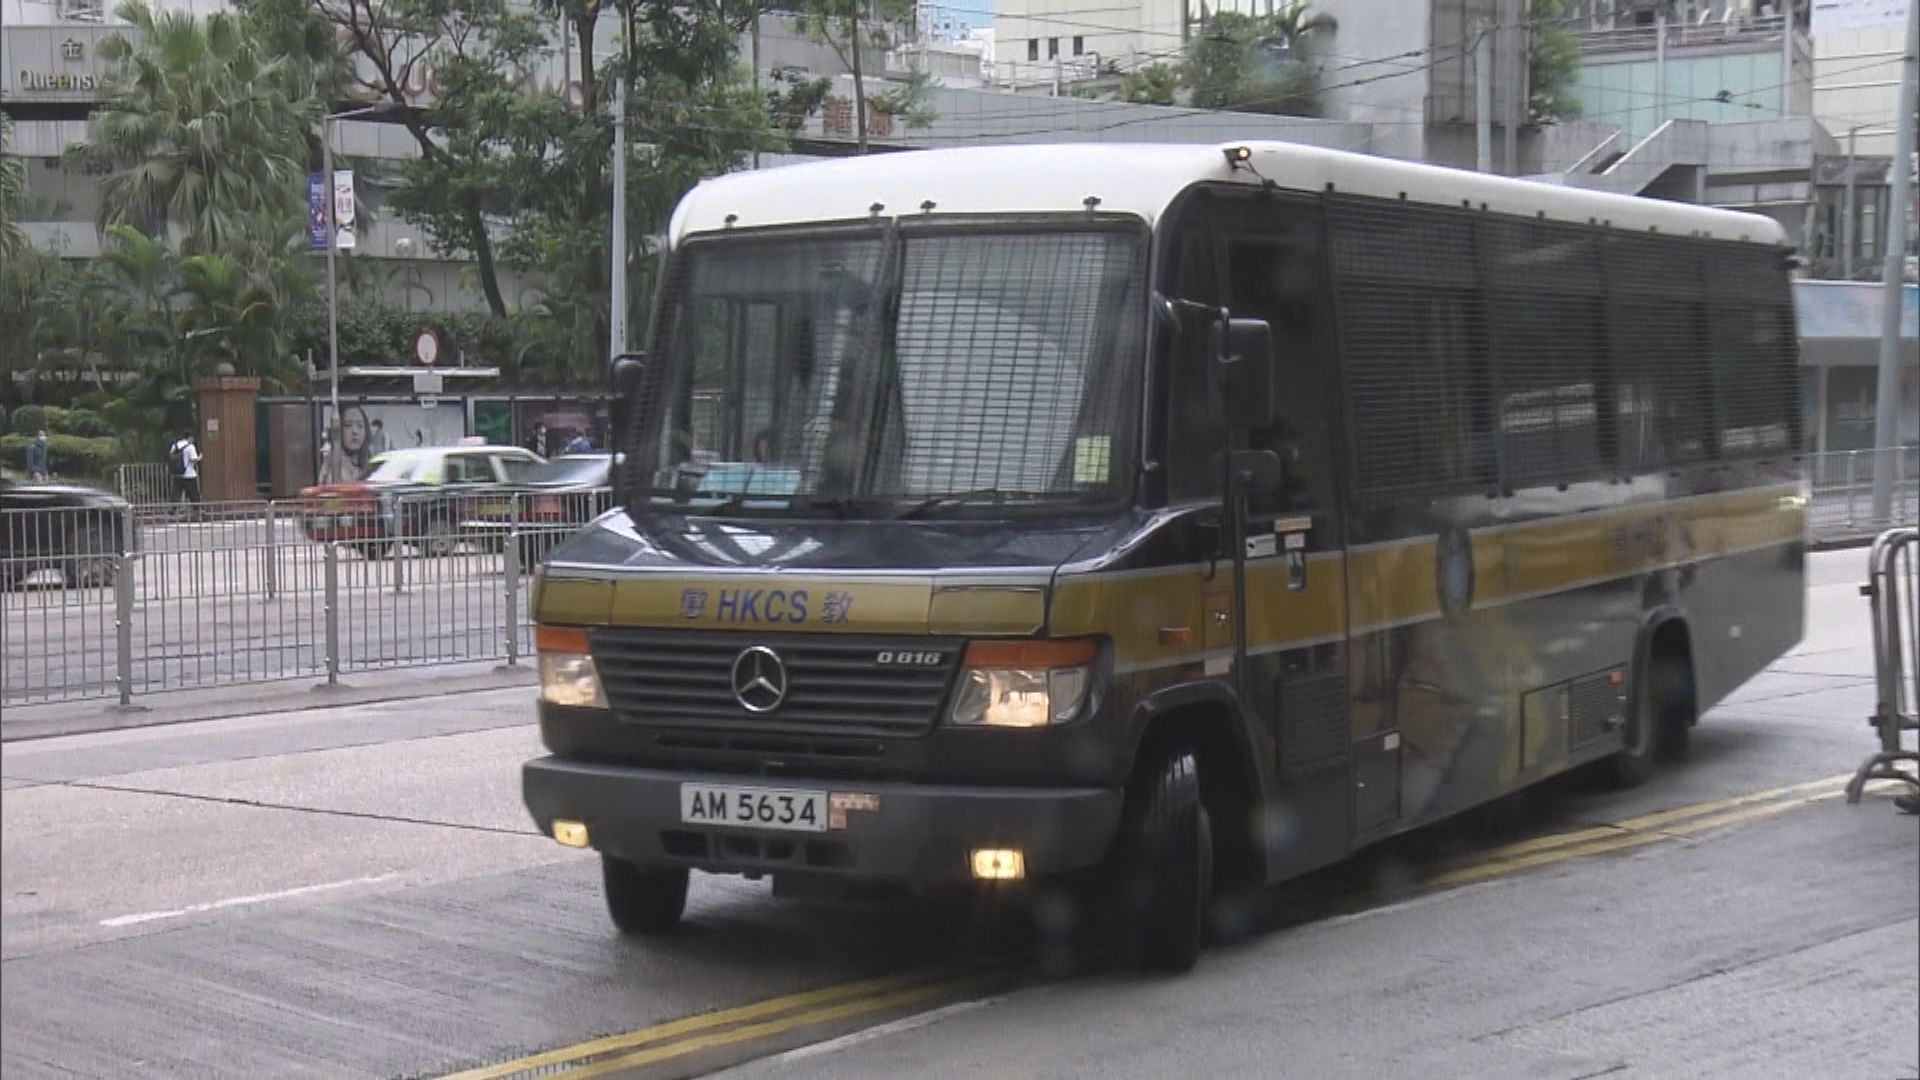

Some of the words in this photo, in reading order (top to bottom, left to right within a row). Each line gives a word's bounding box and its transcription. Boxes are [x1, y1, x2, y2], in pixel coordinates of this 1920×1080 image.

[718, 589, 809, 625] HKCS
[896, 651, 941, 666] 816
[690, 790, 728, 820] AM
[736, 793, 817, 826] 5634
